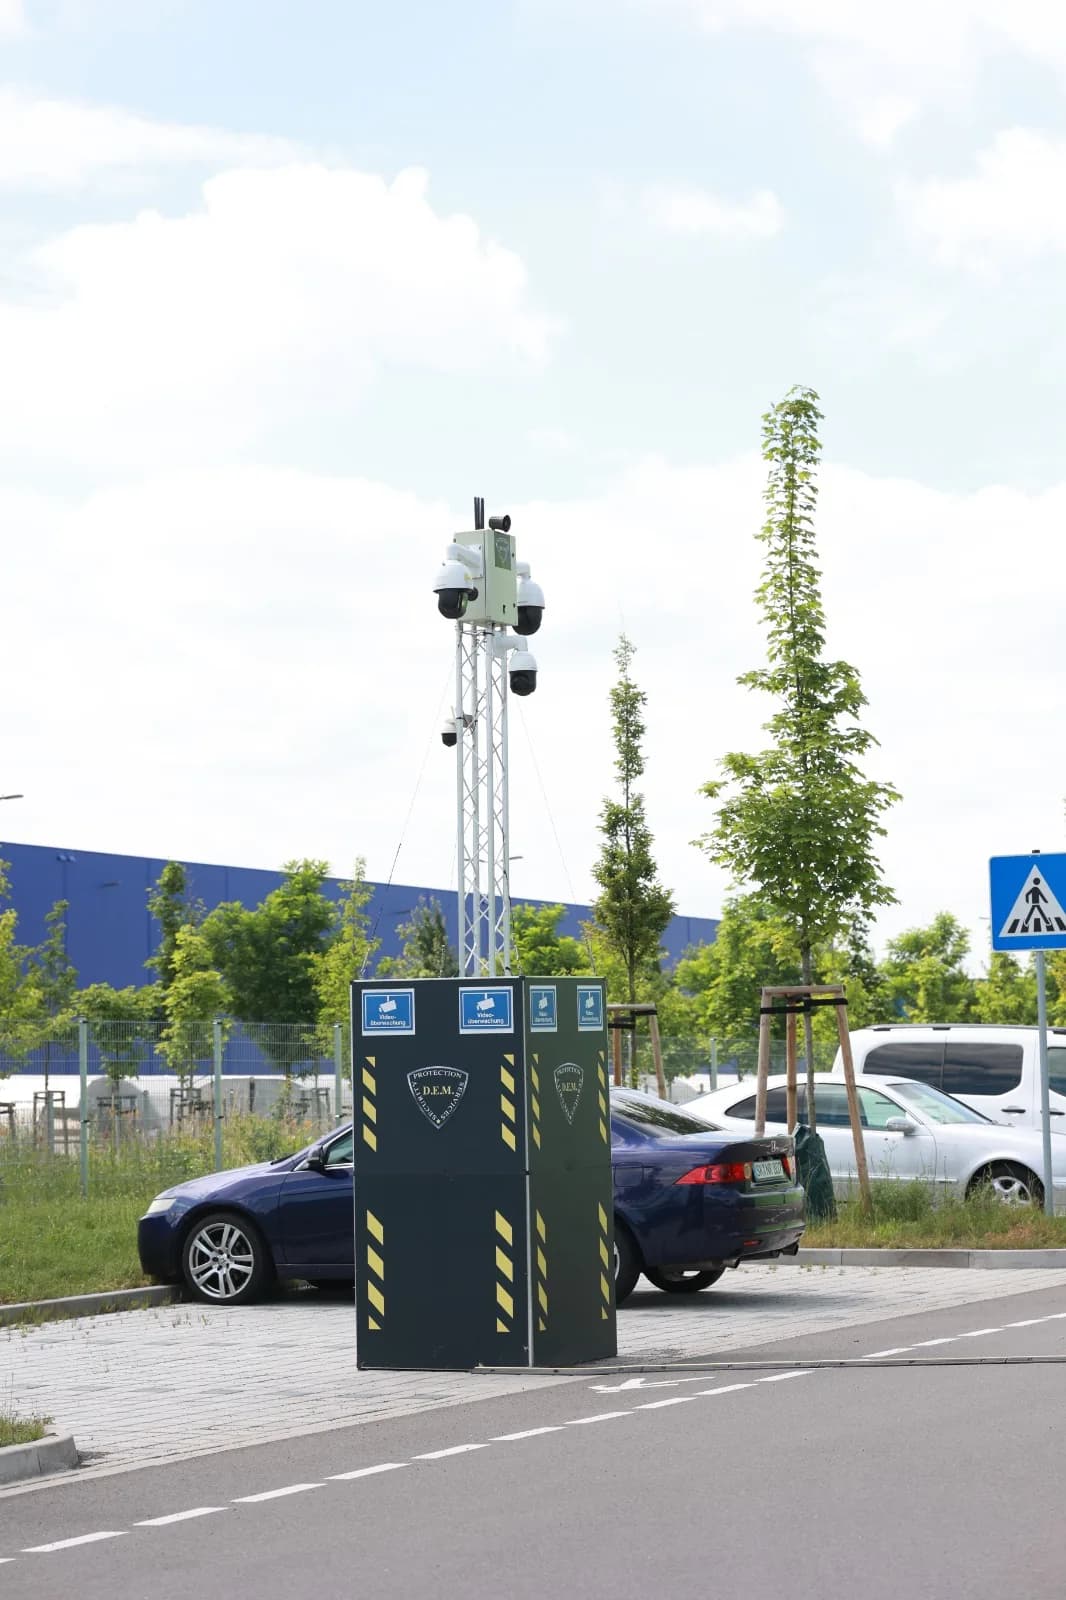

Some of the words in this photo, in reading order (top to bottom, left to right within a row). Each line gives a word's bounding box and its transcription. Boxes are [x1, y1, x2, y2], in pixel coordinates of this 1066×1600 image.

[413, 1070, 463, 1080] PROTECTION
[411, 1081, 438, 1121] SECURITY
[423, 1085, 455, 1096] D.E.M.
[440, 1081, 465, 1120] SERVICES
